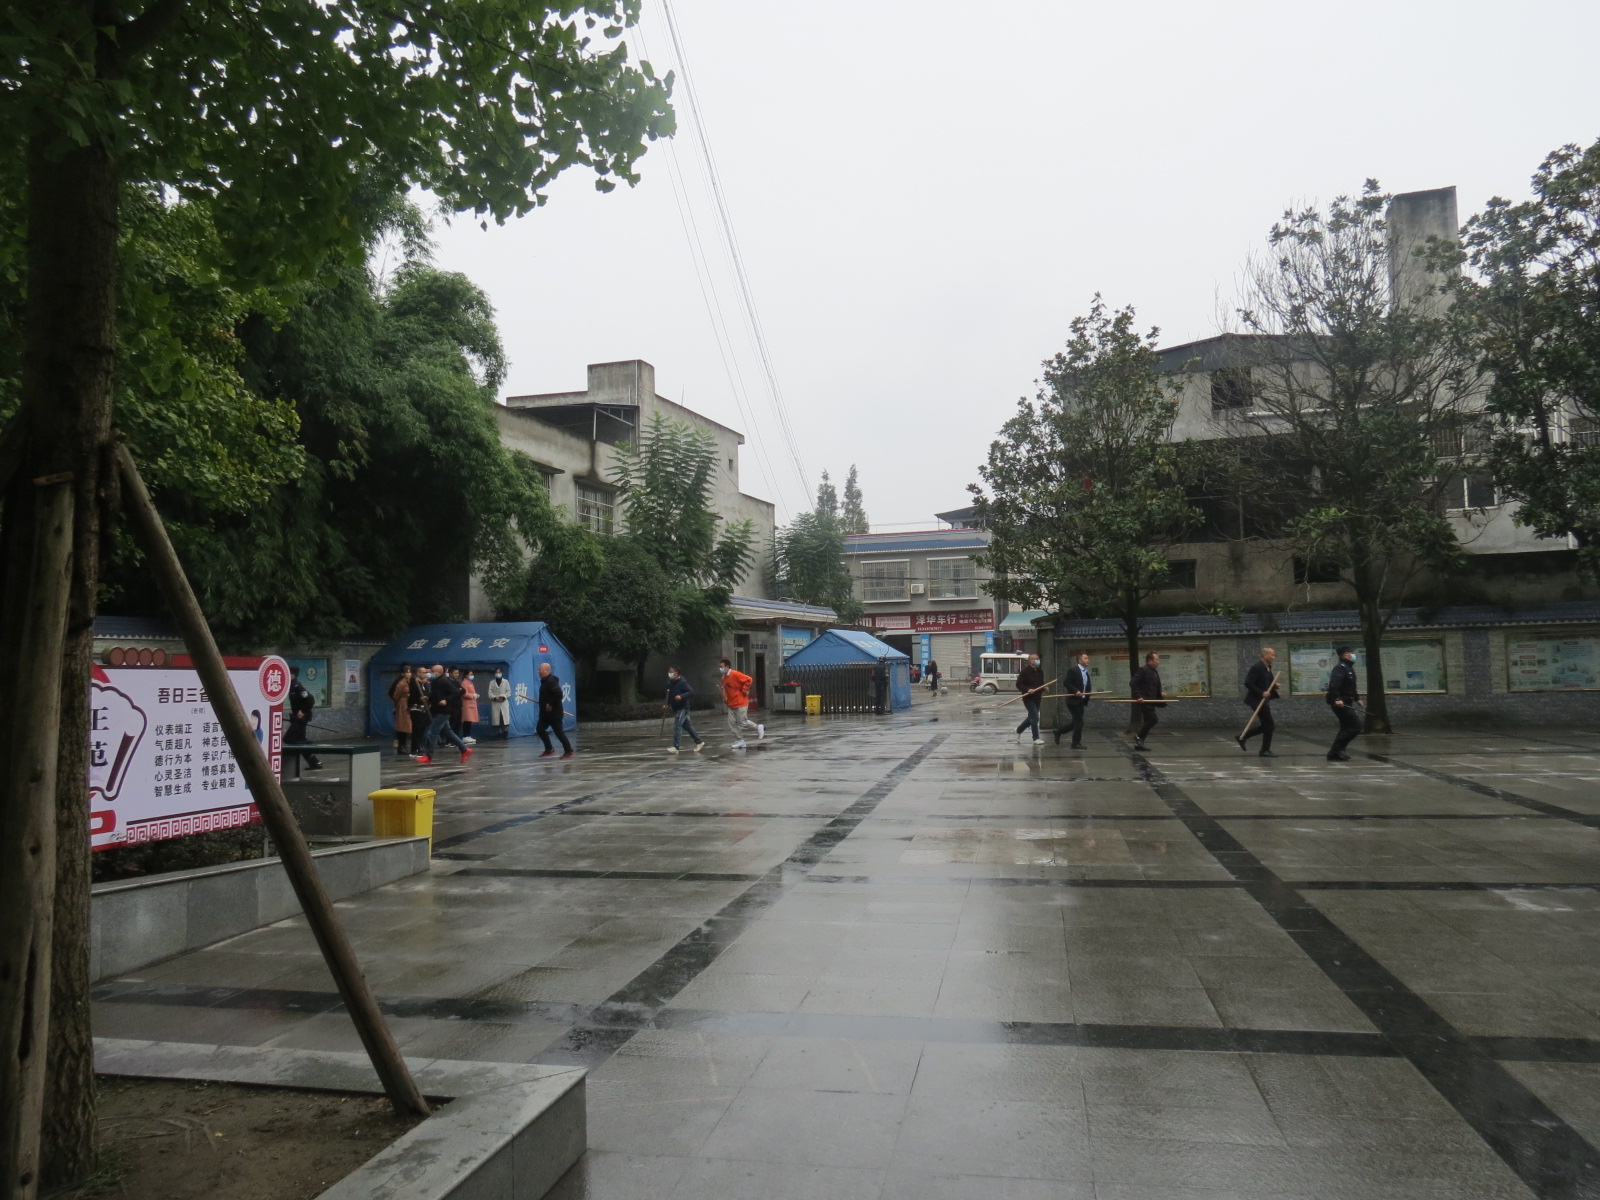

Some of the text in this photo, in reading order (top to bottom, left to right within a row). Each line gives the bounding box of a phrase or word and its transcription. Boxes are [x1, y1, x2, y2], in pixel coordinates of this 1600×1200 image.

[916, 614, 956, 625] 泽华车行
[407, 637, 510, 649] 应急救灾
[266, 669, 282, 693] 德
[157, 687, 210, 704] 吾日三省
[515, 683, 571, 705] 救 灾
[155, 722, 224, 736] 仪表端正 语言
[155, 738, 192, 751] 气质超凡
[154, 753, 192, 767] 德行为本
[154, 763, 236, 782] 心灵圣洁 情感真挚
[154, 777, 235, 797] 智慧生成 专业精湛
